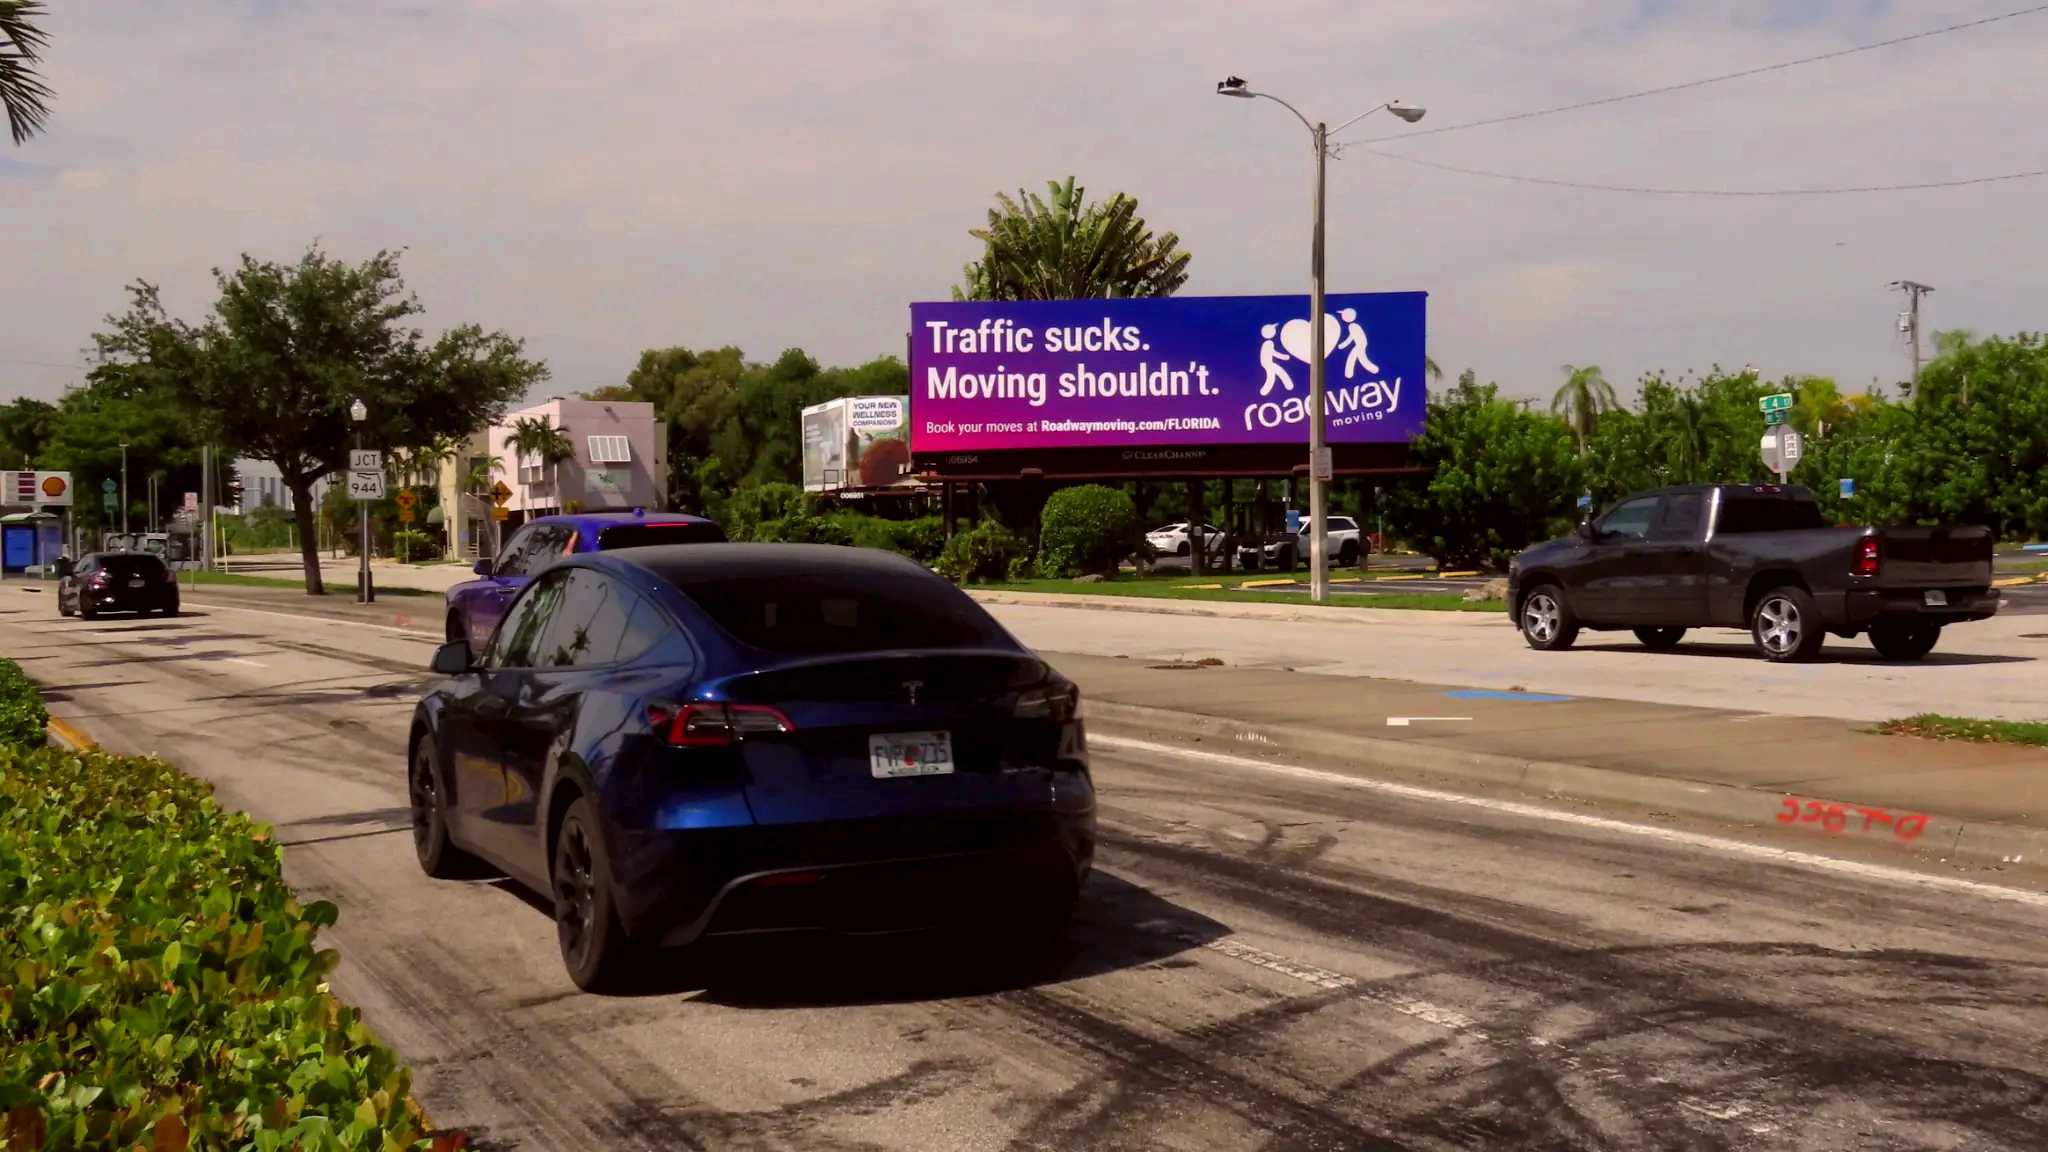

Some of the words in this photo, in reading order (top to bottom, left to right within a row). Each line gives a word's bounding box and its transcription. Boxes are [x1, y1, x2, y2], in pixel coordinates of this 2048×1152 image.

[926, 318, 1034, 353] Traffic
[1045, 317, 1150, 352] sucks.
[928, 365, 1046, 406] Moving
[1058, 361, 1220, 397] shouldn't.
[853, 402, 876, 410] YOUR
[852, 410, 897, 419] WELLNESS
[1332, 410, 1383, 428] moving
[926, 421, 955, 434] Book
[958, 423, 983, 436] your
[986, 422, 1023, 433] moves
[1027, 422, 1038, 432] at
[1041, 417, 1221, 434] Roadwaymoving.com/FLORIDA
[355, 454, 377, 466] JCT
[352, 483, 376, 493] 944
